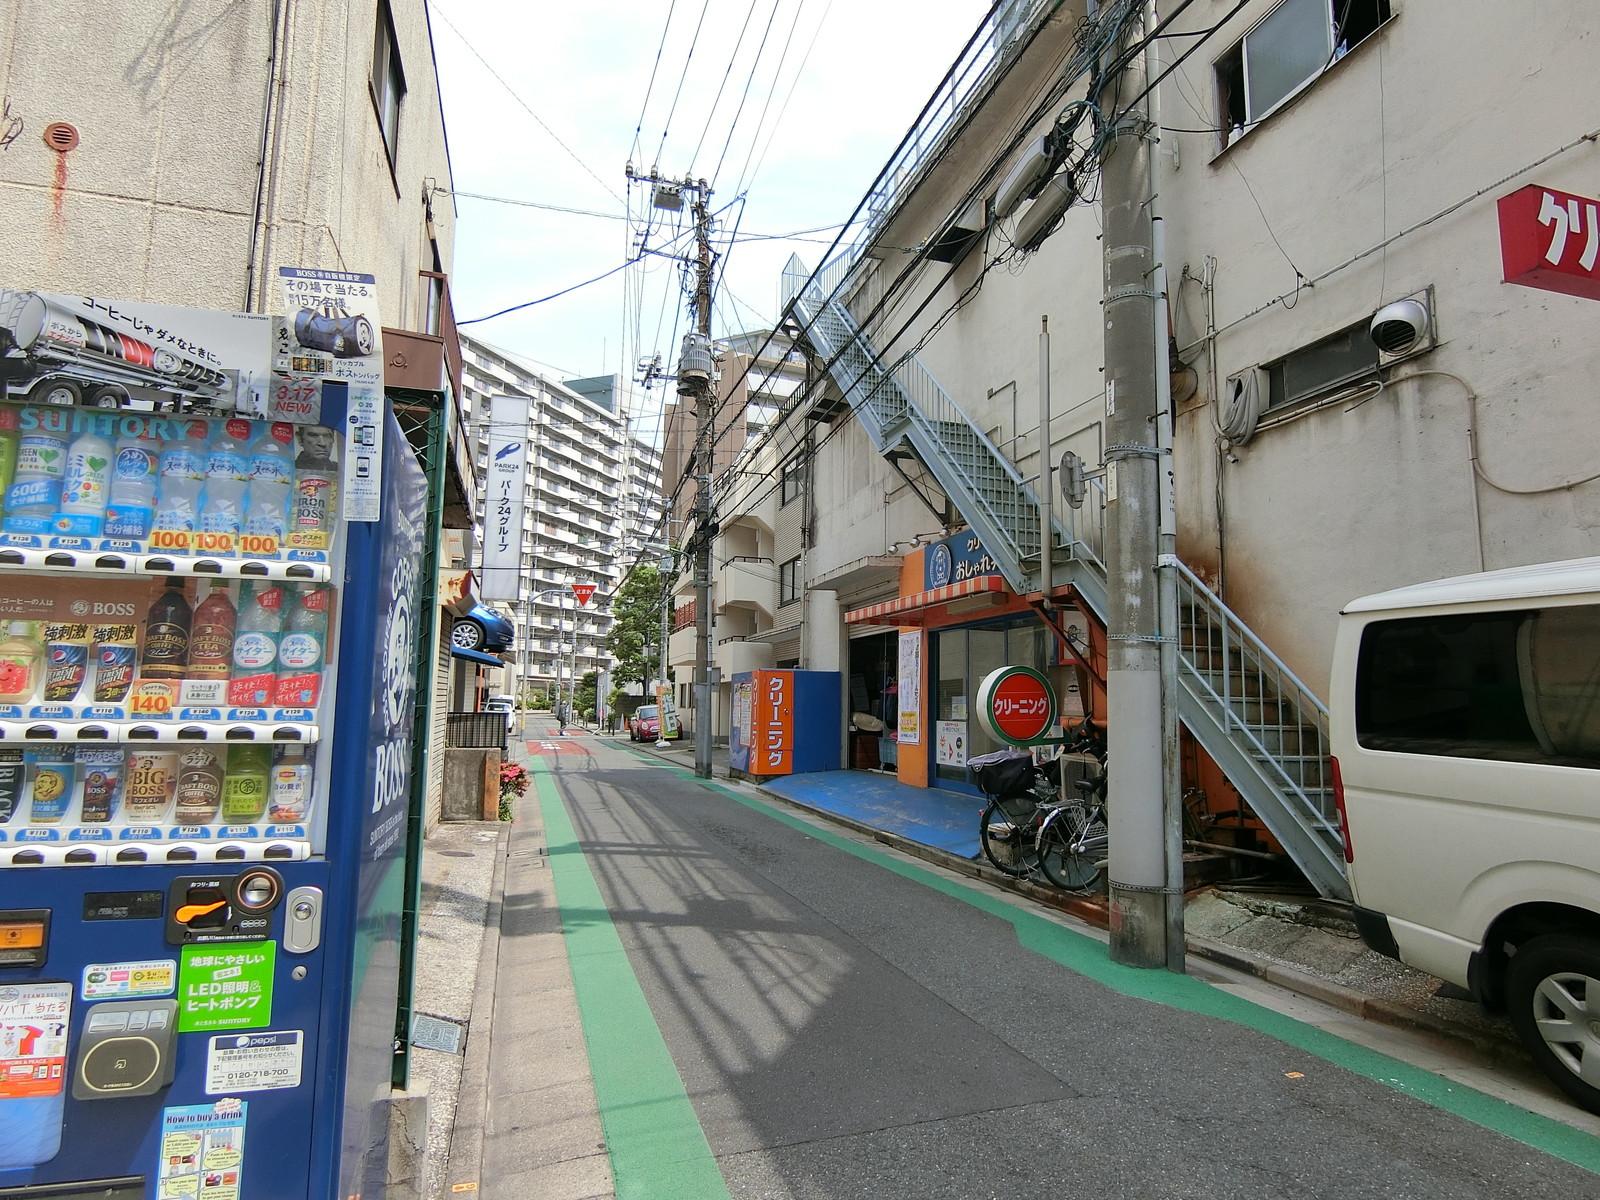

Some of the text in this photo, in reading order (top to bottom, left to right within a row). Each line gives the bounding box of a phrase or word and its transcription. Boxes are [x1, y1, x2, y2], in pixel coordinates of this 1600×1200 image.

[296, 269, 316, 278] BOSS
[285, 279, 374, 298] その場で当たる。
[82, 296, 222, 366] コーヒーじゃダメなときに。
[176, 358, 226, 388] BOSS
[276, 385, 315, 402] 3.17
[274, 401, 313, 414] NEW!
[19, 407, 196, 441] SUNTORY
[494, 462, 519, 470] PARK24
[497, 480, 511, 552] パーク24グループ
[104, 523, 143, 537] 塩分補給
[152, 531, 191, 550] 100円
[195, 533, 234, 552] 100円
[240, 536, 278, 555] 100円
[92, 602, 136, 616] BOSS
[43, 623, 89, 642] 強刺激
[92, 624, 137, 644] 強刺激
[235, 646, 273, 655] サイダー
[281, 646, 317, 656] サイダー
[230, 689, 255, 703] サイダー
[276, 689, 301, 703] サイダー
[131, 695, 171, 713] 140円
[994, 697, 1048, 716] クリーニング
[768, 677, 784, 766] クリーニング
[186, 755, 210, 765] ラテ!
[133, 770, 165, 785] BIG
[372, 737, 407, 814] BOSS
[132, 785, 165, 796] BOSS
[198, 782, 217, 792] BOSS
[242, 781, 255, 793] 茶
[189, 954, 266, 967] 地球にやさしい
[187, 979, 262, 997] LED照明&
[35, 1001, 67, 1014] 当たる
[186, 994, 262, 1012] ヒートポンプ
[217, 1017, 252, 1025] SUNTORY
[250, 1035, 278, 1046] pepsi
[227, 1068, 289, 1080] 0120-718-700
[166, 1115, 186, 1124] How
[186, 1114, 195, 1122] to
[197, 1113, 213, 1122] buy
[221, 1110, 244, 1120] drink
